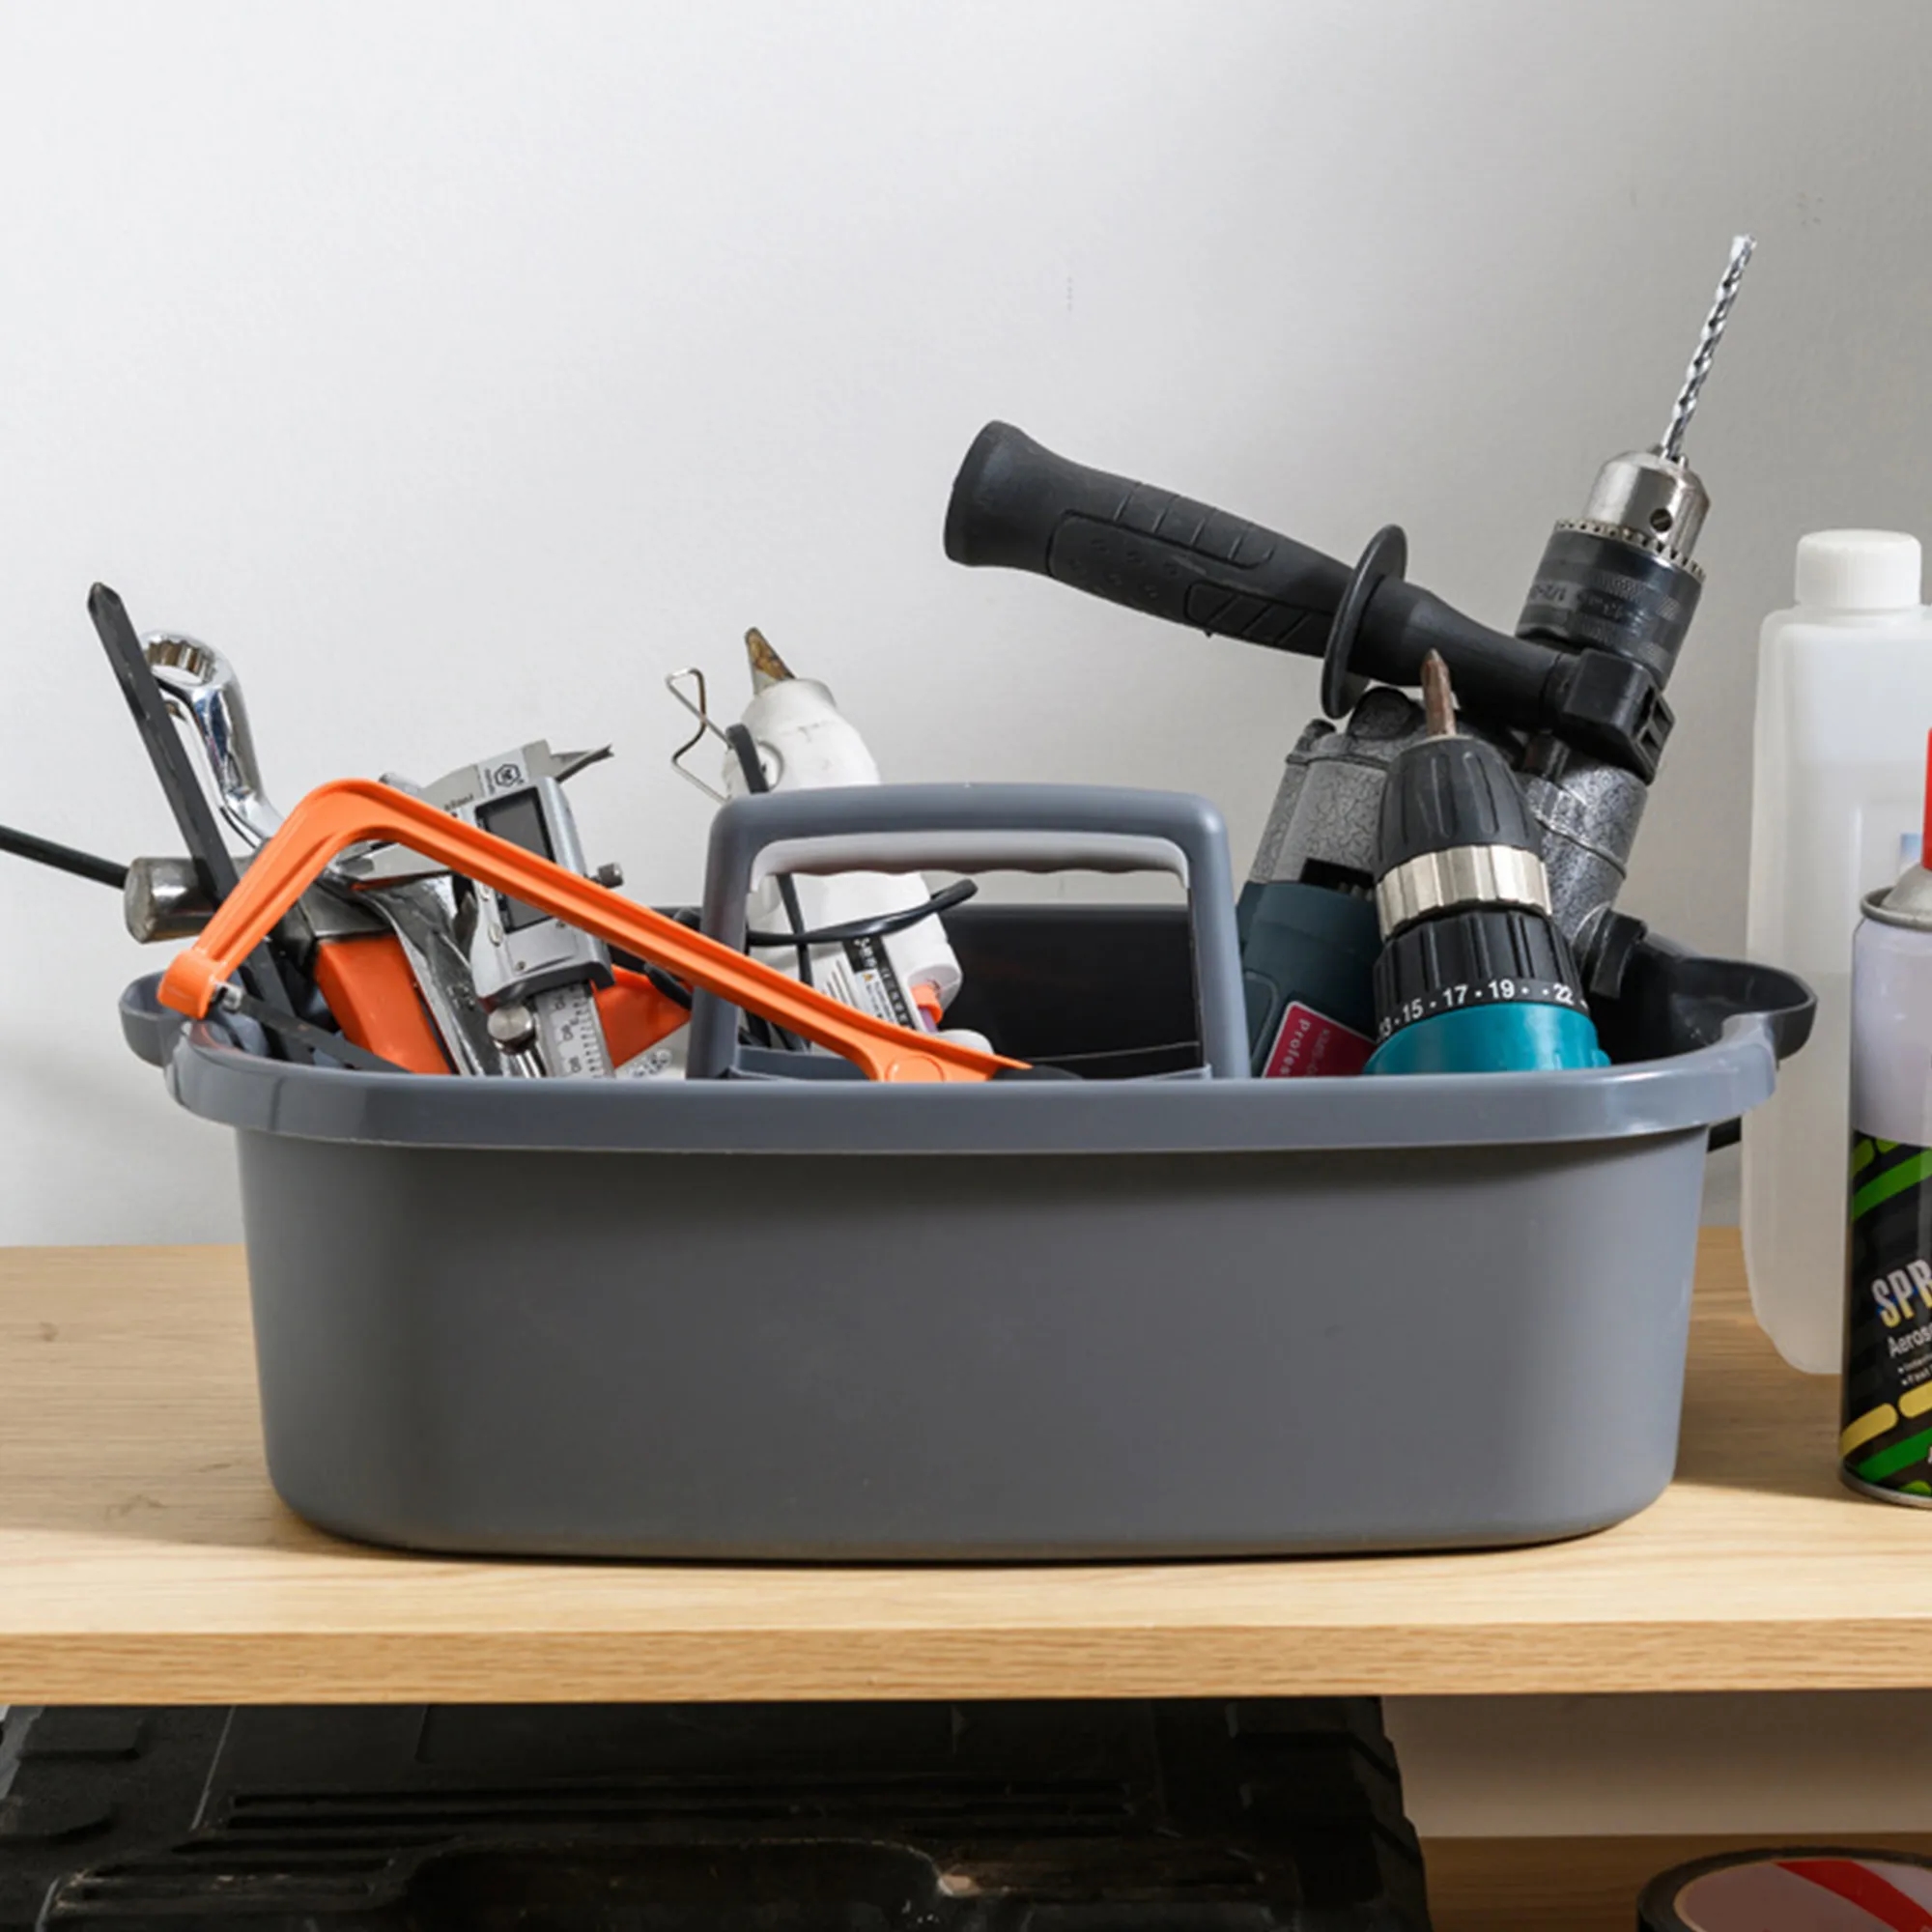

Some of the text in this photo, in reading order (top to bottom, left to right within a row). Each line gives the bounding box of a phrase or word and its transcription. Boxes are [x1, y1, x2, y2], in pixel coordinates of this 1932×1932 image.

[1403, 998, 1424, 1022] 15
[1443, 984, 1468, 1007] 17
[1489, 979, 1515, 999] 19
[1553, 982, 1575, 1006] 22
[1871, 1259, 1932, 1327] SPR
